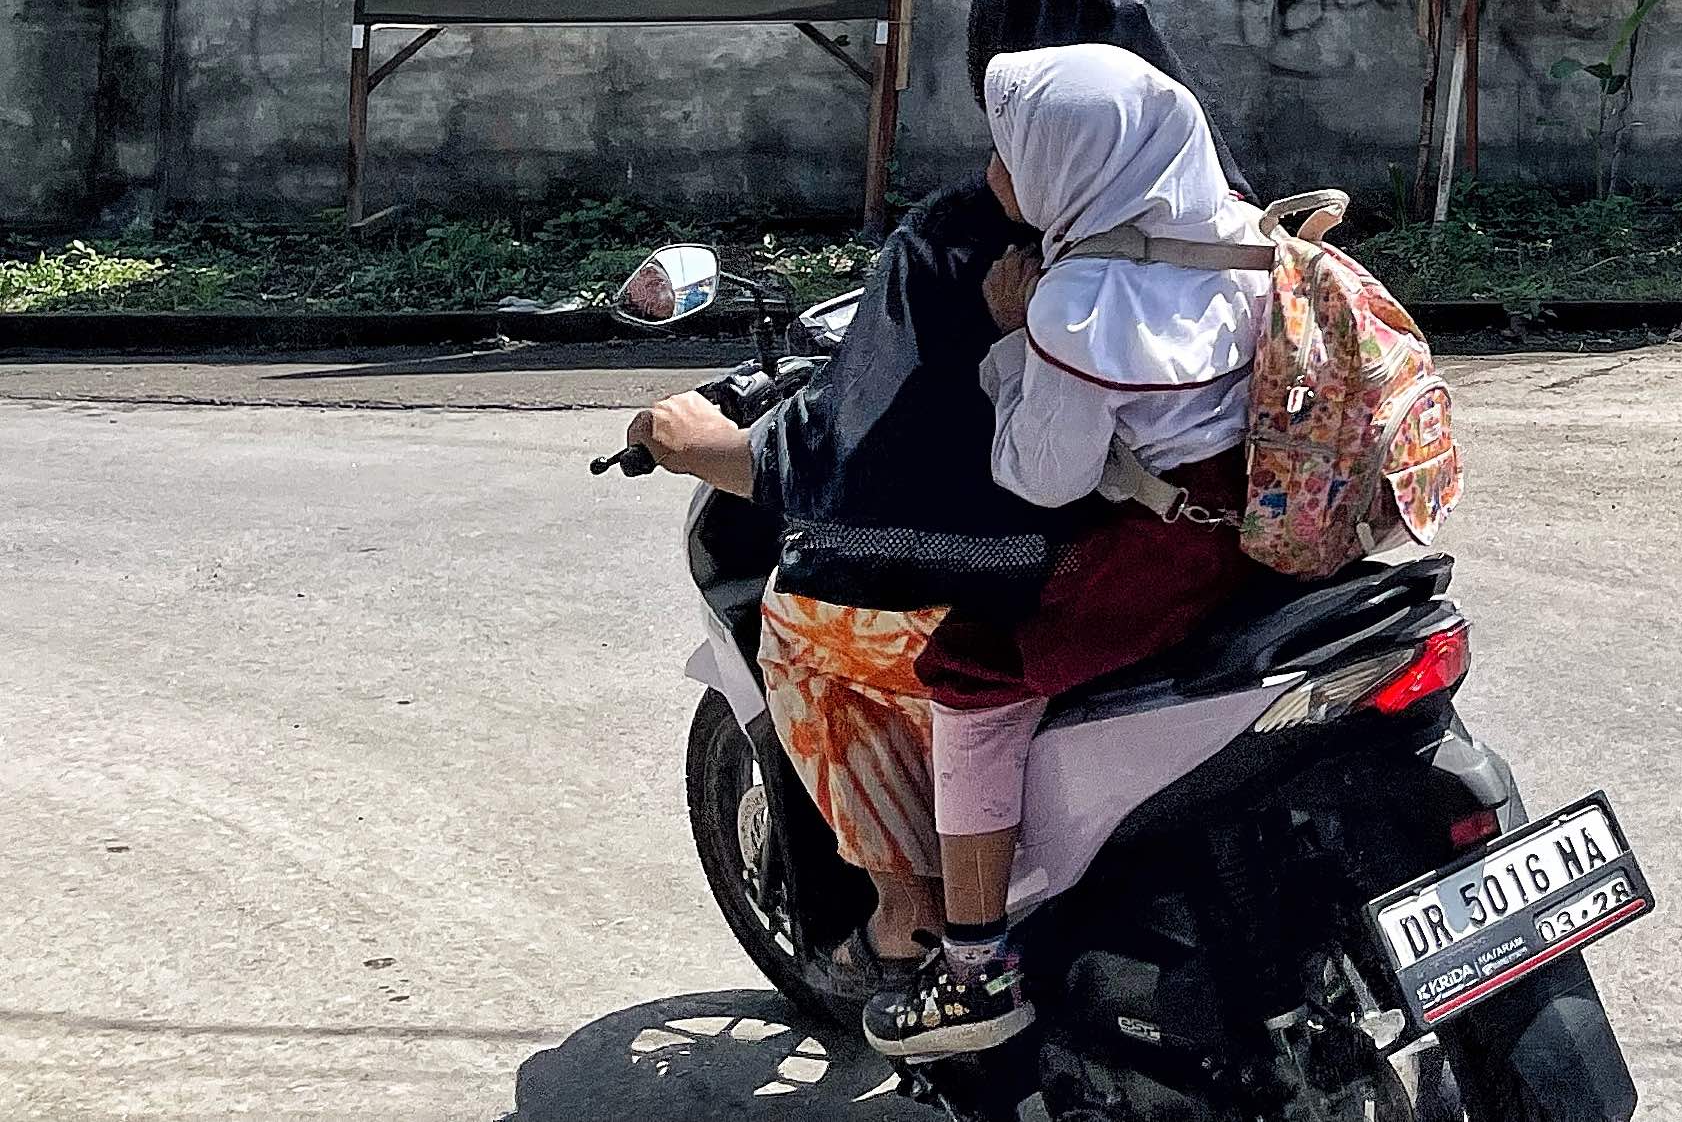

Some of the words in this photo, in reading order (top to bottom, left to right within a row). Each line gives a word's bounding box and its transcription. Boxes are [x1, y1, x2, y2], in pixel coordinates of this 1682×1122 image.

[1399, 903, 1453, 961] DR
[1459, 853, 1550, 928] 5016
[1553, 826, 1607, 880] NA
